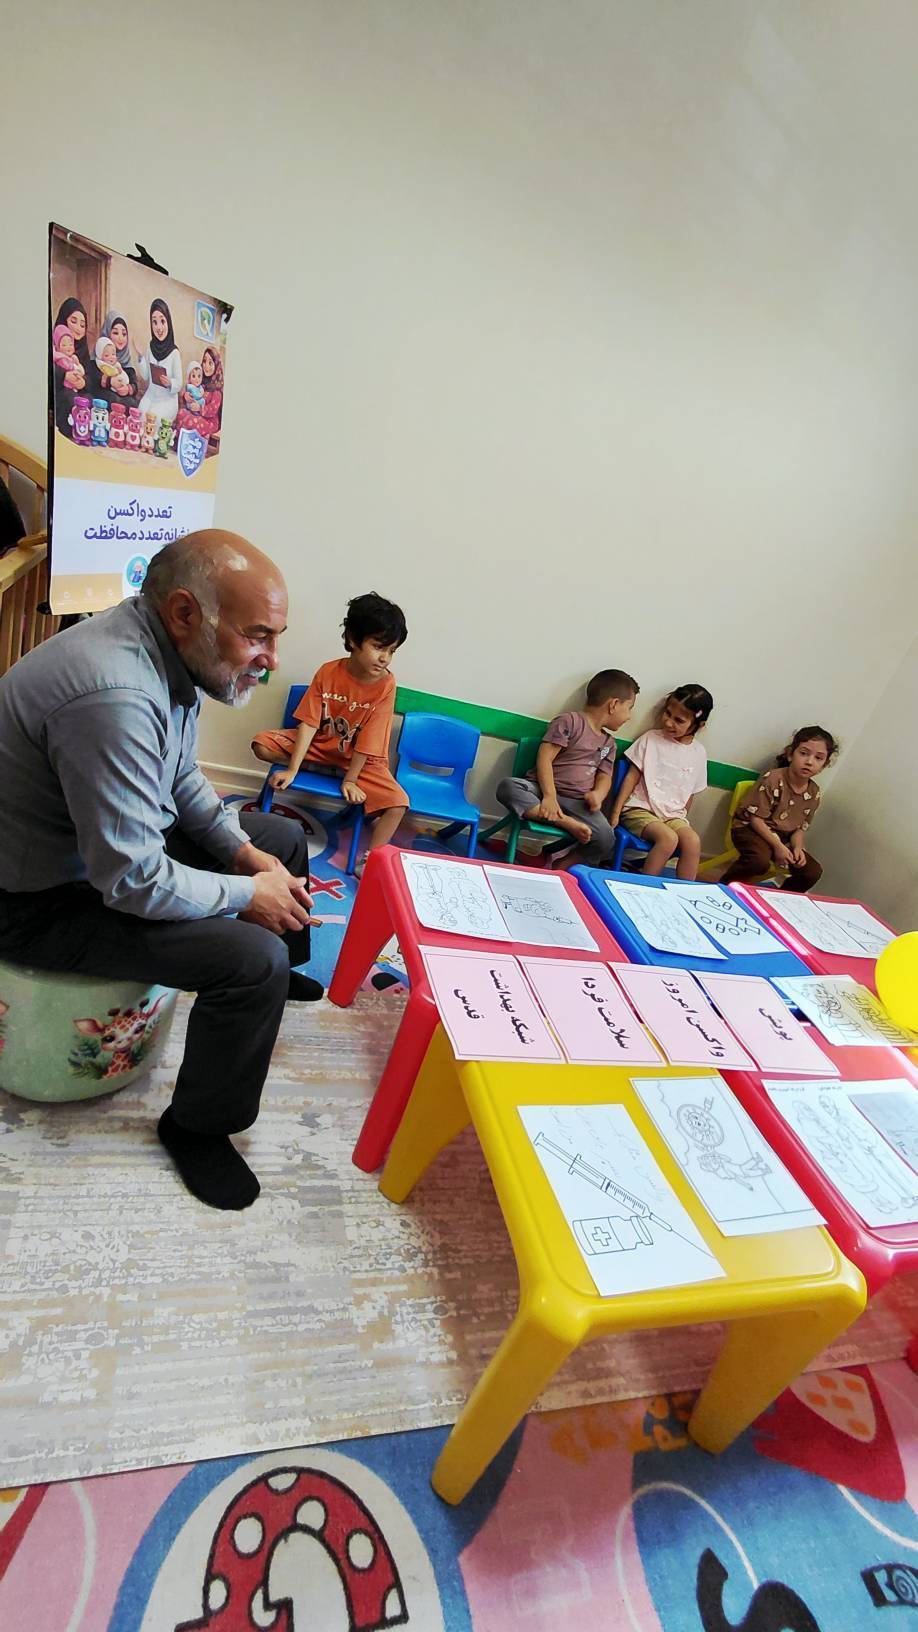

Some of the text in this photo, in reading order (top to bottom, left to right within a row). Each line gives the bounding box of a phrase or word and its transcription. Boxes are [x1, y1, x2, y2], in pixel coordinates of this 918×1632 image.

[107, 499, 173, 522] تعدد واکسن
[84, 523, 138, 540] محافظت
[138, 528, 164, 540] تعدد
[453, 989, 486, 1019] قدس
[489, 969, 535, 1045] شبکه بهداشت
[581, 977, 630, 1049] سلامت فردا
[661, 979, 725, 1058] واکسن امروز
